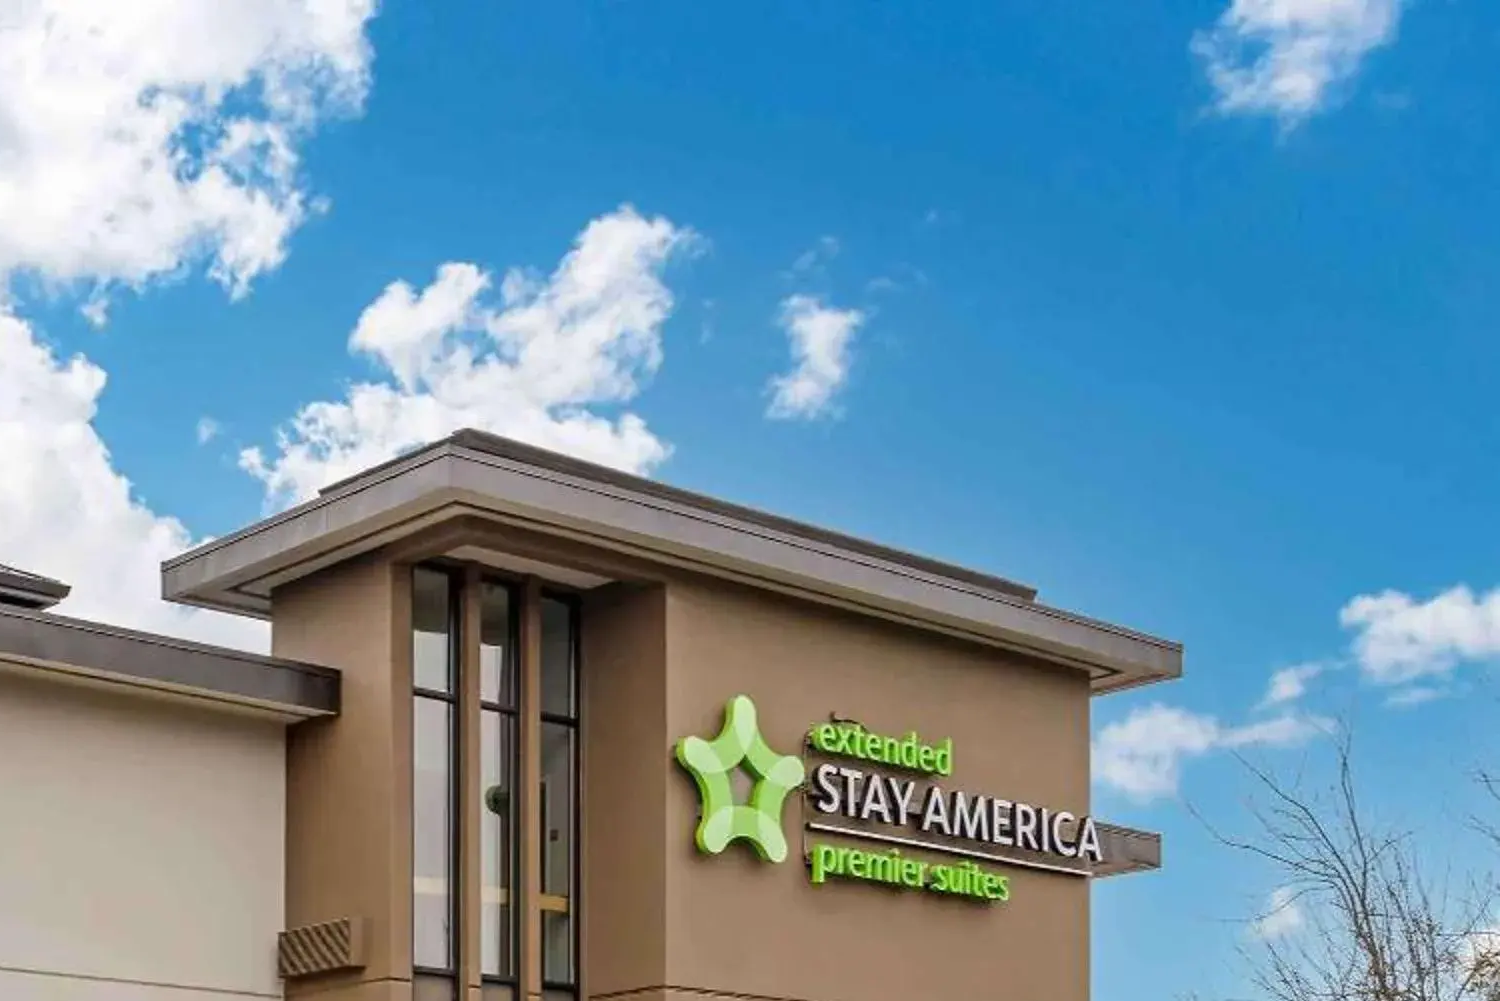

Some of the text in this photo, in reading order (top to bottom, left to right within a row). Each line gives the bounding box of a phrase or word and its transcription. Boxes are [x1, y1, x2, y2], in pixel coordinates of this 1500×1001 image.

[812, 722, 953, 776] extended
[815, 763, 1103, 862] STAY AMERICA
[813, 844, 1010, 902] premier suites
